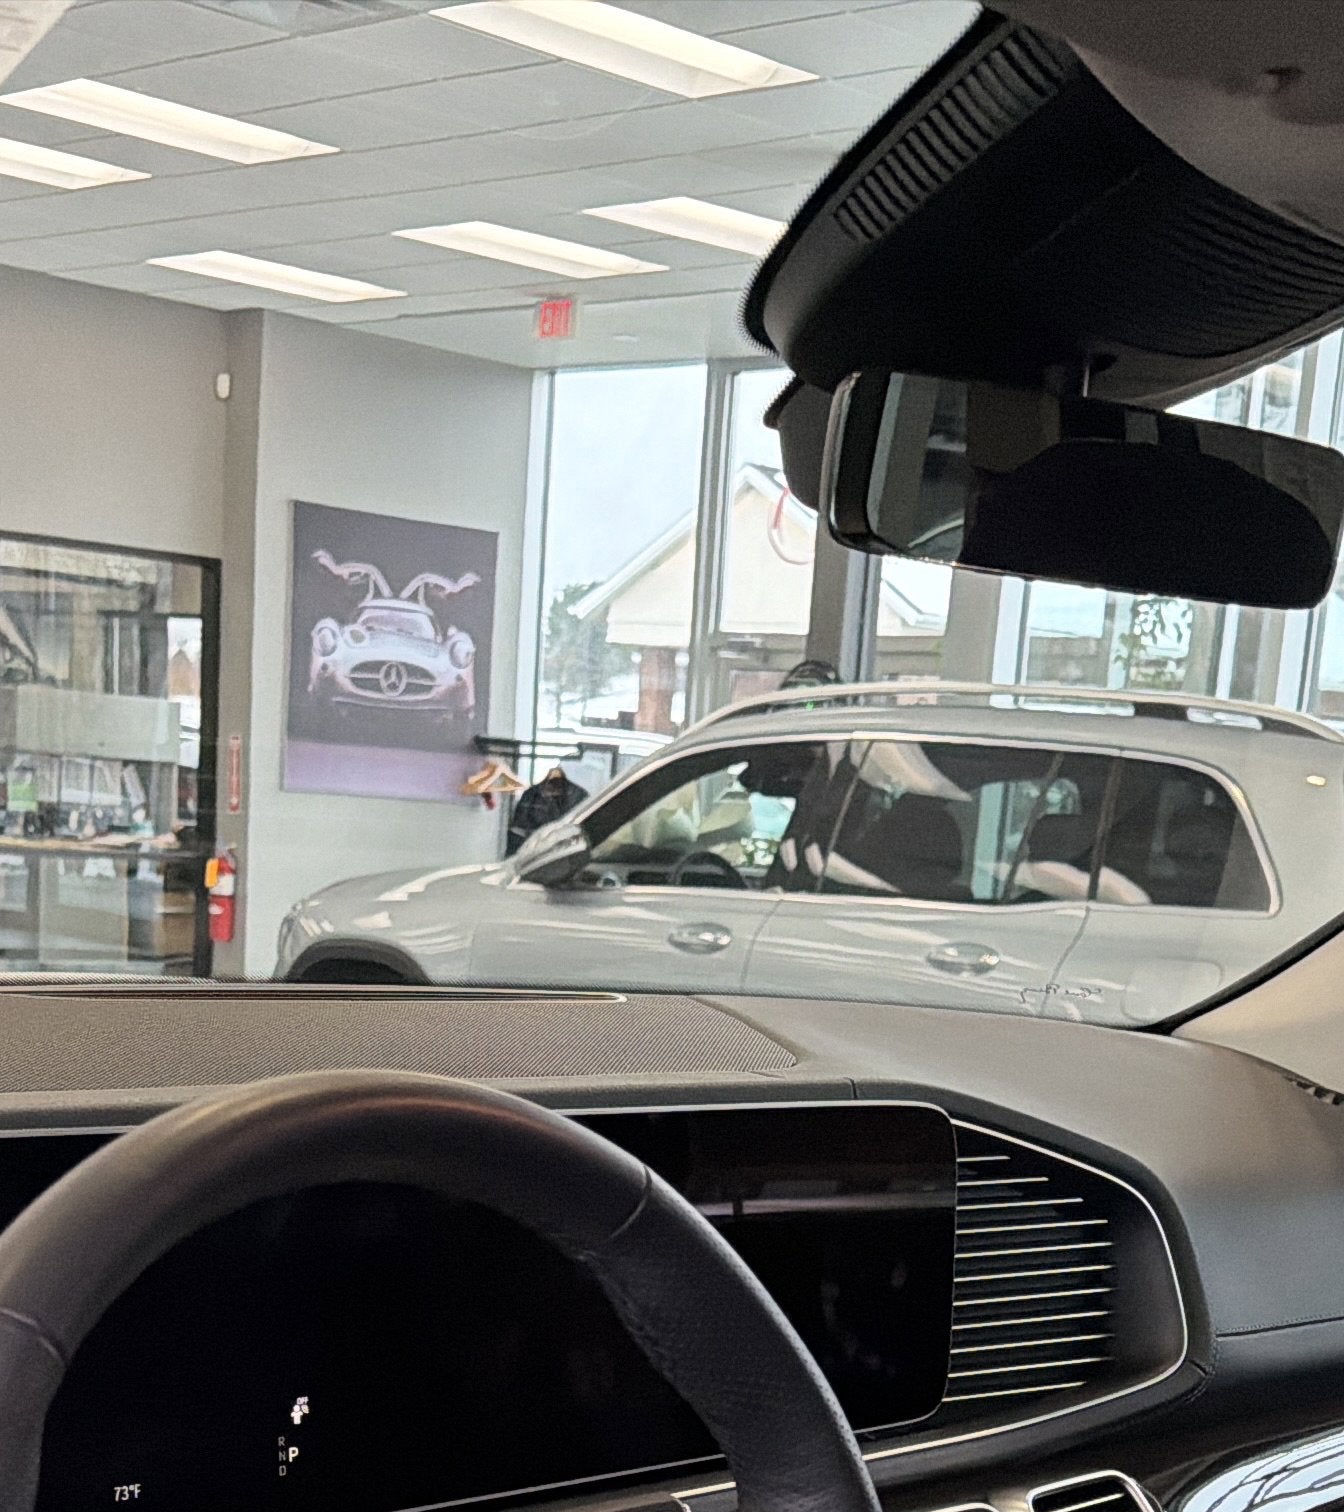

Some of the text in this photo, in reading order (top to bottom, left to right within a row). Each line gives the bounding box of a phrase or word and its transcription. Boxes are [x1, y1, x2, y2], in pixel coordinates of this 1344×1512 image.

[278, 1436, 285, 1446] R
[279, 1450, 286, 1461] N
[288, 1447, 299, 1462] P
[279, 1465, 287, 1476] D
[113, 1483, 141, 1502] 73°F
